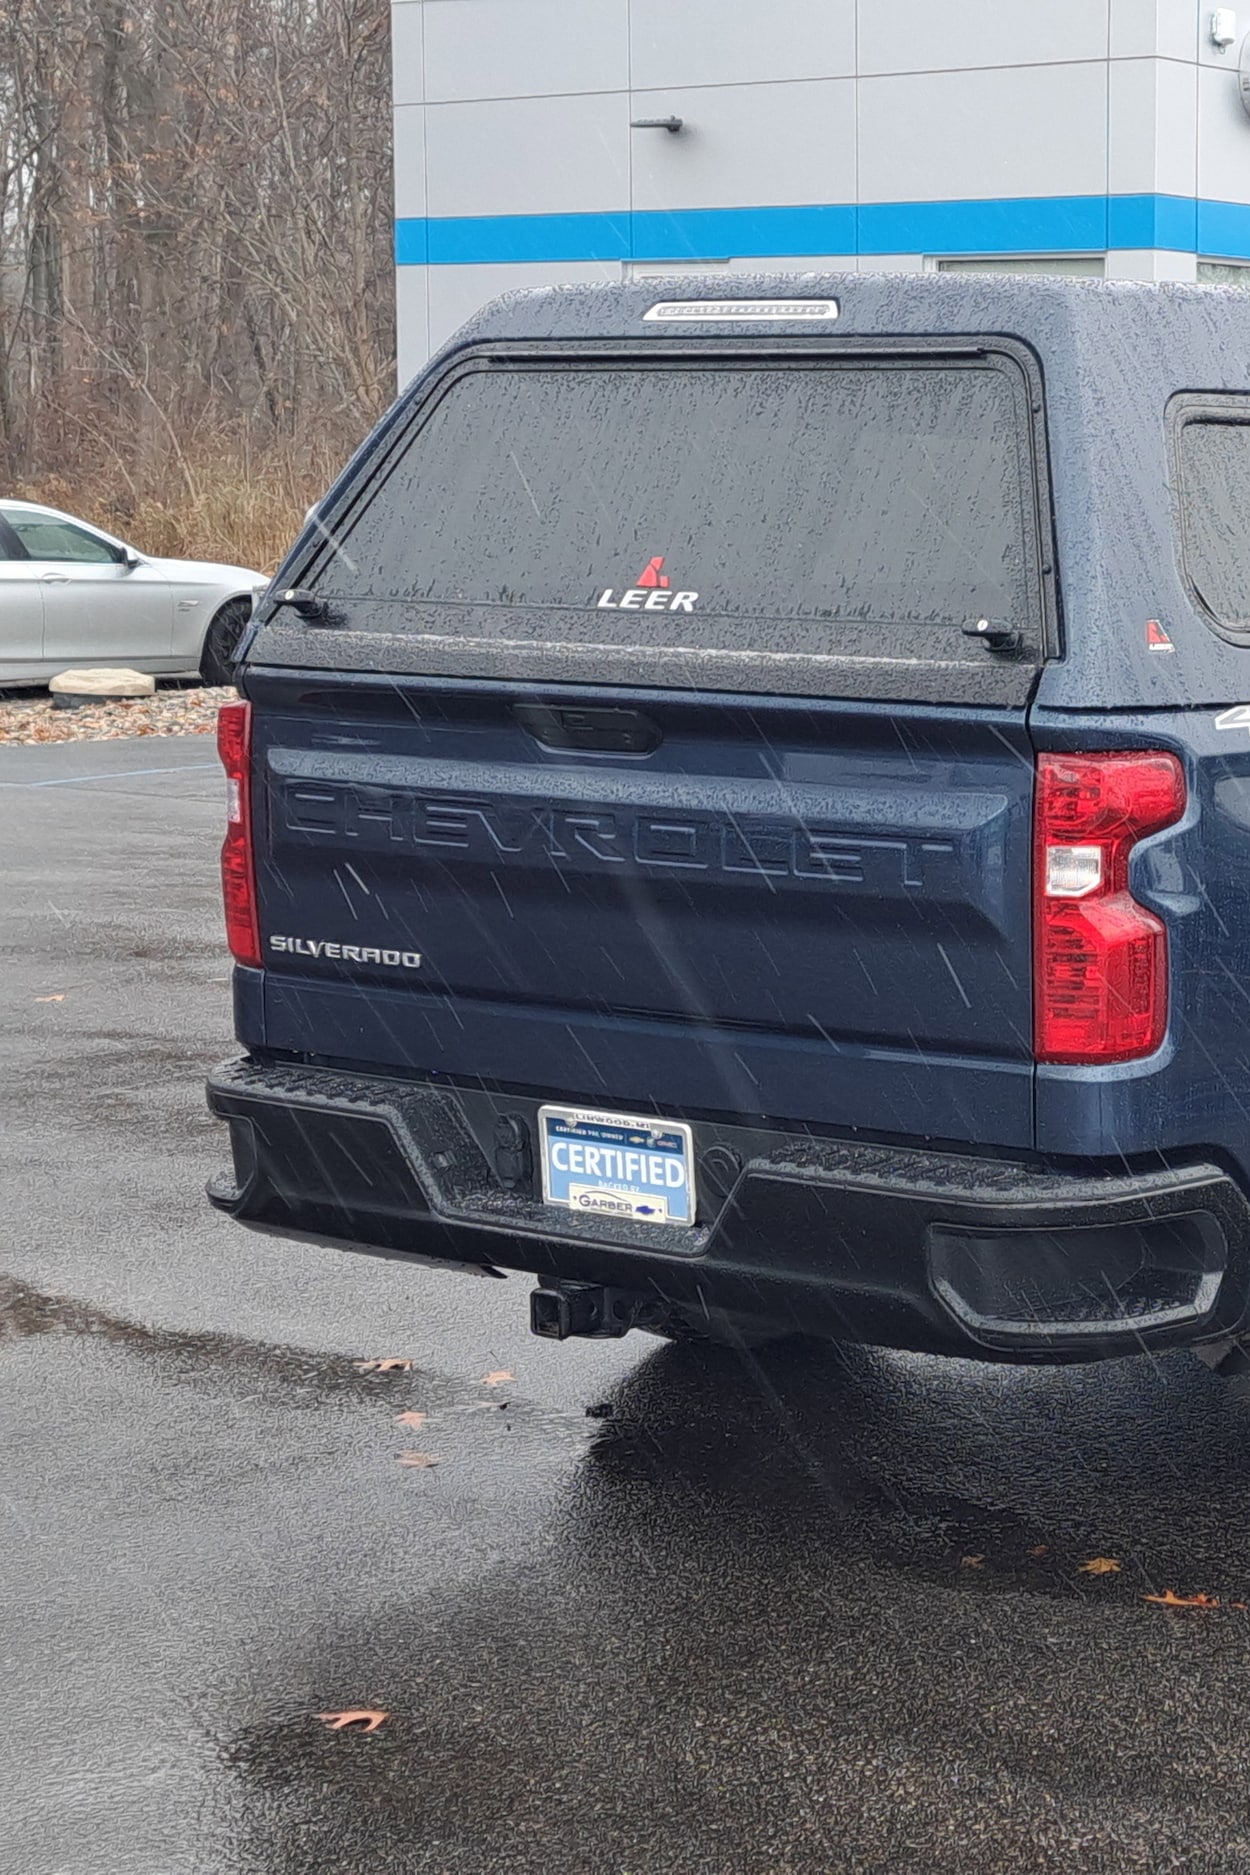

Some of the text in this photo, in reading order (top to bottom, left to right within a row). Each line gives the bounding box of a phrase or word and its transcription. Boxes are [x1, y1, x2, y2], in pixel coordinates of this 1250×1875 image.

[597, 588, 700, 612] LEER
[285, 785, 954, 886] CHEVROLET
[269, 934, 422, 969] SILVERADO
[551, 1141, 686, 1188] CERTIFIED
[579, 1194, 634, 1213] GARBER
